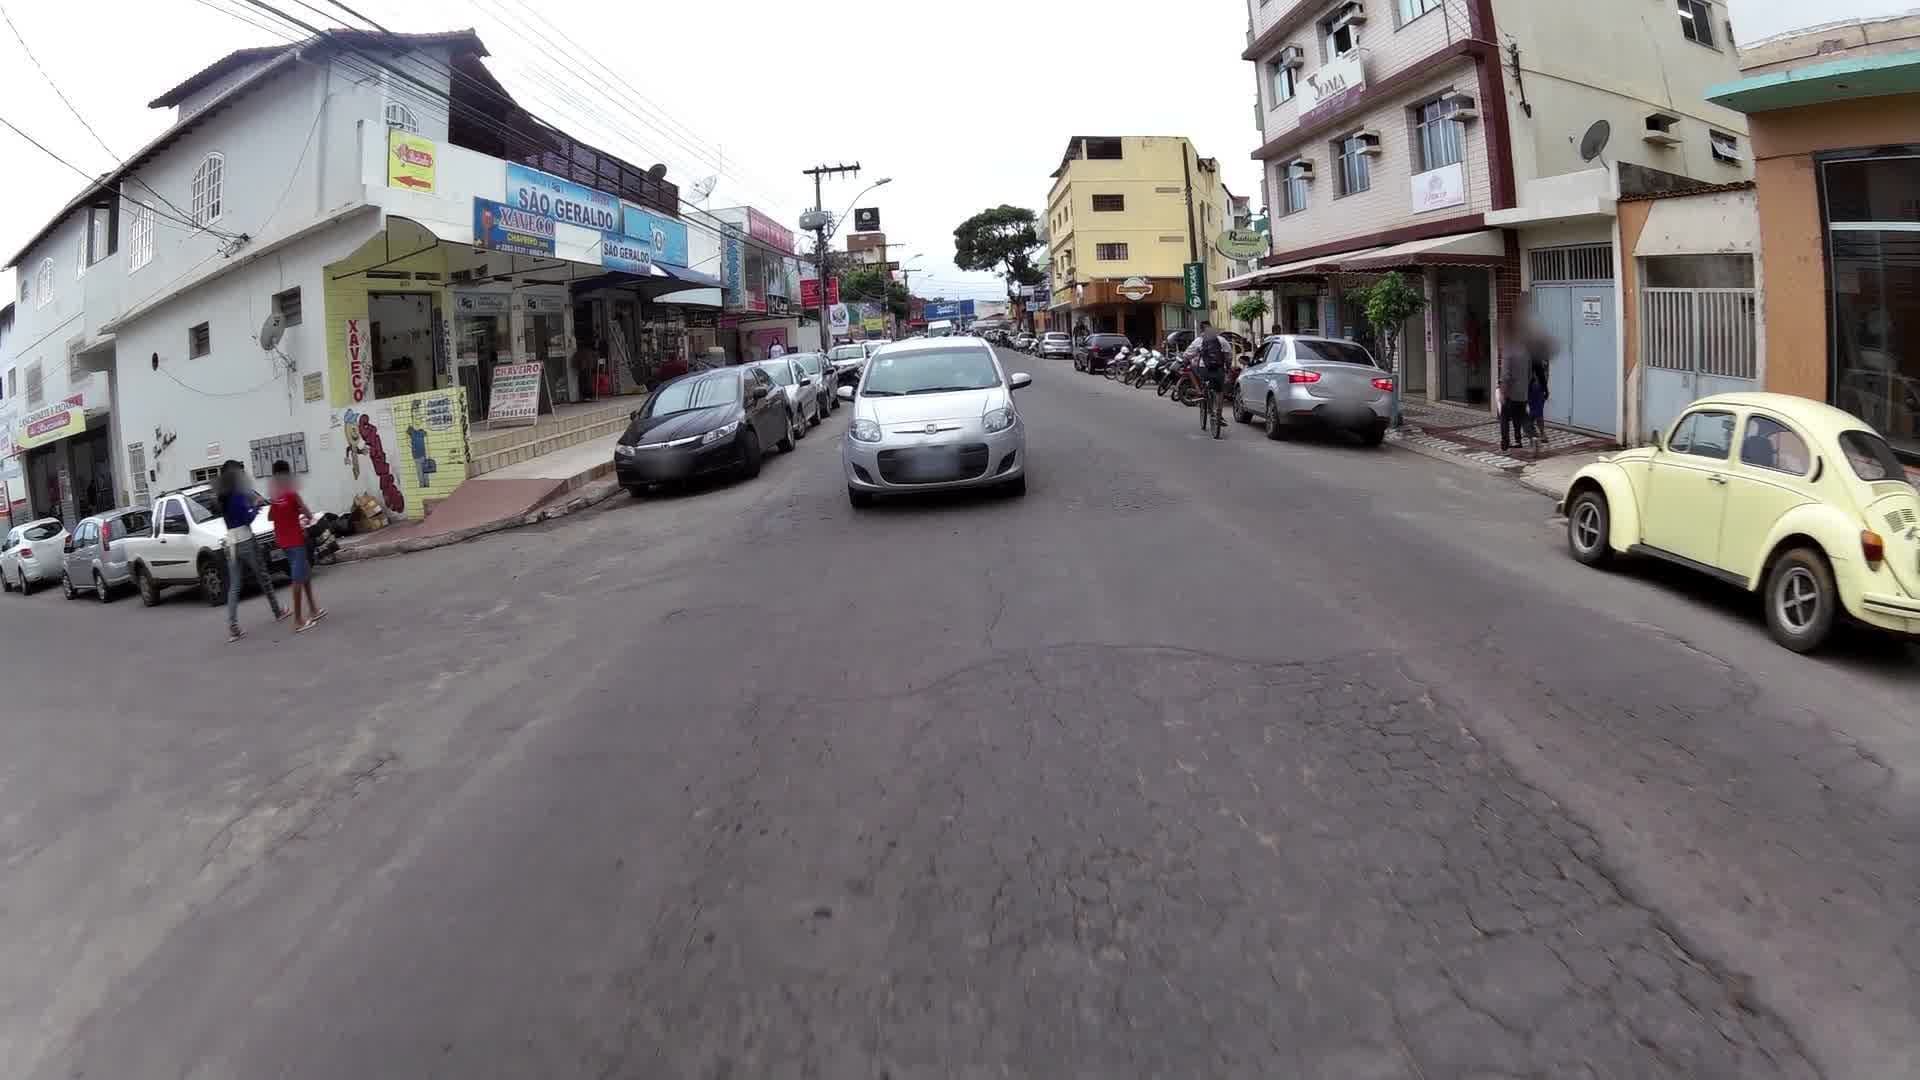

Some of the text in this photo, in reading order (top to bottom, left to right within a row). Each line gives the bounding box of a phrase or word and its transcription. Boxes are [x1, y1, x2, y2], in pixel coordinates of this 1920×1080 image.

[499, 206, 555, 236] XAVECO
[518, 187, 551, 216] SÃO
[555, 198, 614, 230] GERALDO
[619, 246, 650, 264] GERALDO
[348, 319, 364, 402] XAVECO
[495, 364, 540, 377] CHAVEIRO
